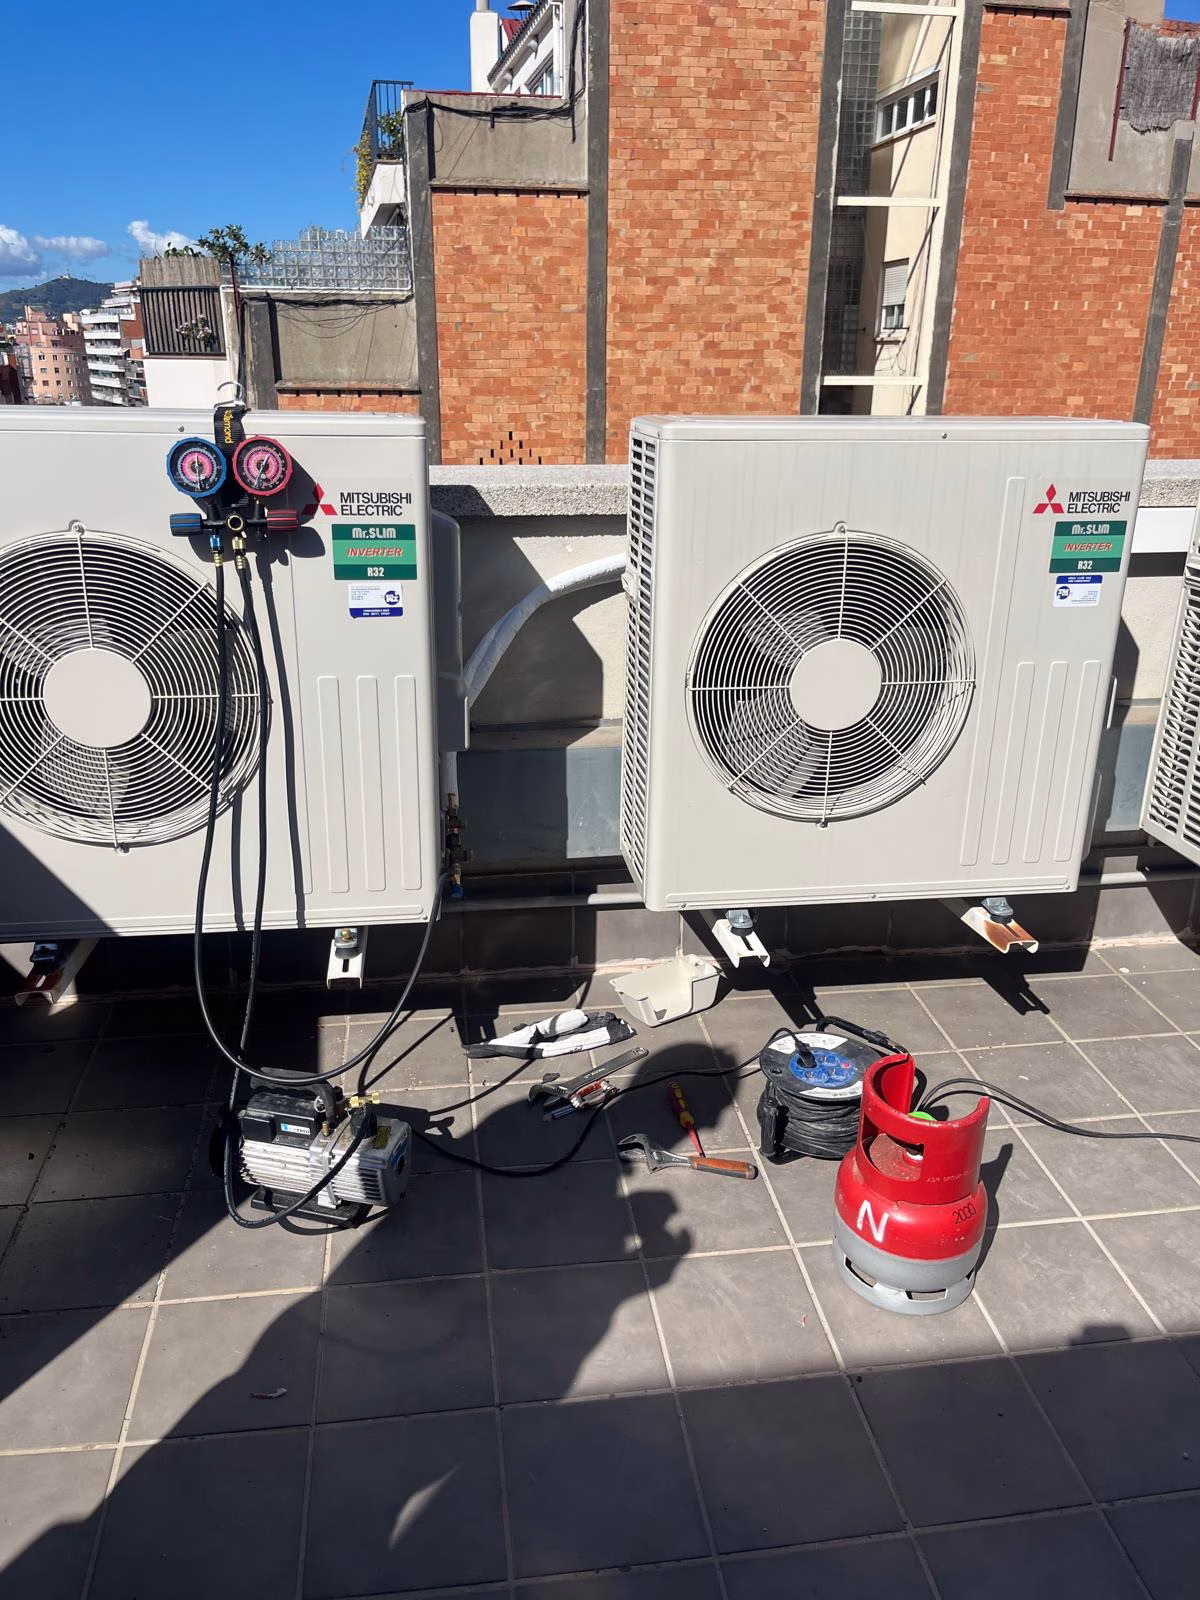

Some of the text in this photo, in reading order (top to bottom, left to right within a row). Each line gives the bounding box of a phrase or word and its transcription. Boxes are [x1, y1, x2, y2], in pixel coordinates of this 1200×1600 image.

[340, 492, 412, 504] MITSUBISHI
[1068, 491, 1131, 503] MITSUBISHI
[341, 504, 403, 516] ELECTRIC
[1067, 503, 1121, 514] ELECTRIC
[346, 547, 403, 558] INVERTER
[1063, 542, 1112, 552] INVERTER
[1077, 560, 1093, 570] R32
[367, 567, 385, 577] R32
[856, 1199, 890, 1242] N
